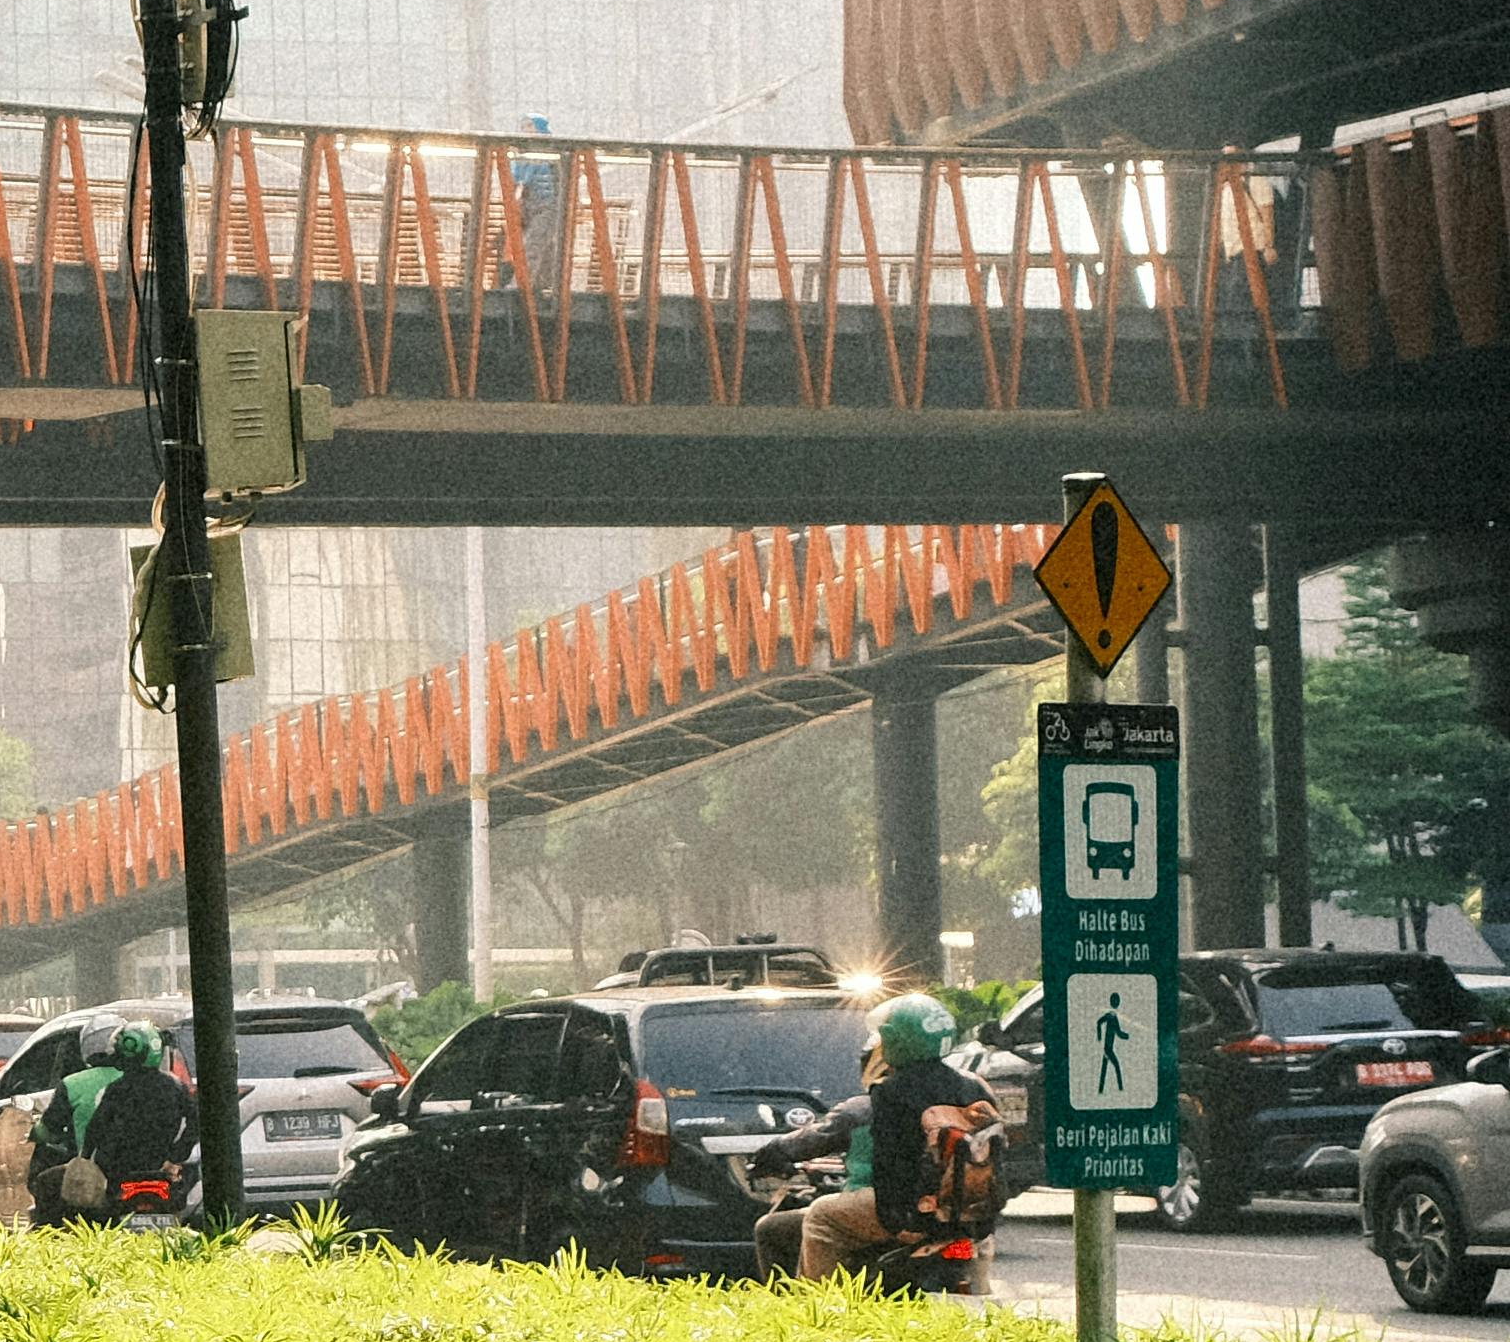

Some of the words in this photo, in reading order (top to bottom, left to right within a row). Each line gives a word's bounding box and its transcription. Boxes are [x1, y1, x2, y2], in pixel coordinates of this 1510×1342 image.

[1123, 725, 1174, 743] Jakarta
[1078, 910, 1118, 932] Halte
[1120, 910, 1146, 932] Bus
[1074, 939, 1150, 966] Dihadapan
[266, 1117, 274, 1132] B
[1056, 1125, 1086, 1148] Beri
[1088, 1124, 1140, 1152] Pejalan
[1142, 1122, 1172, 1145] Kaki
[1084, 1156, 1144, 1178] Prioritas
